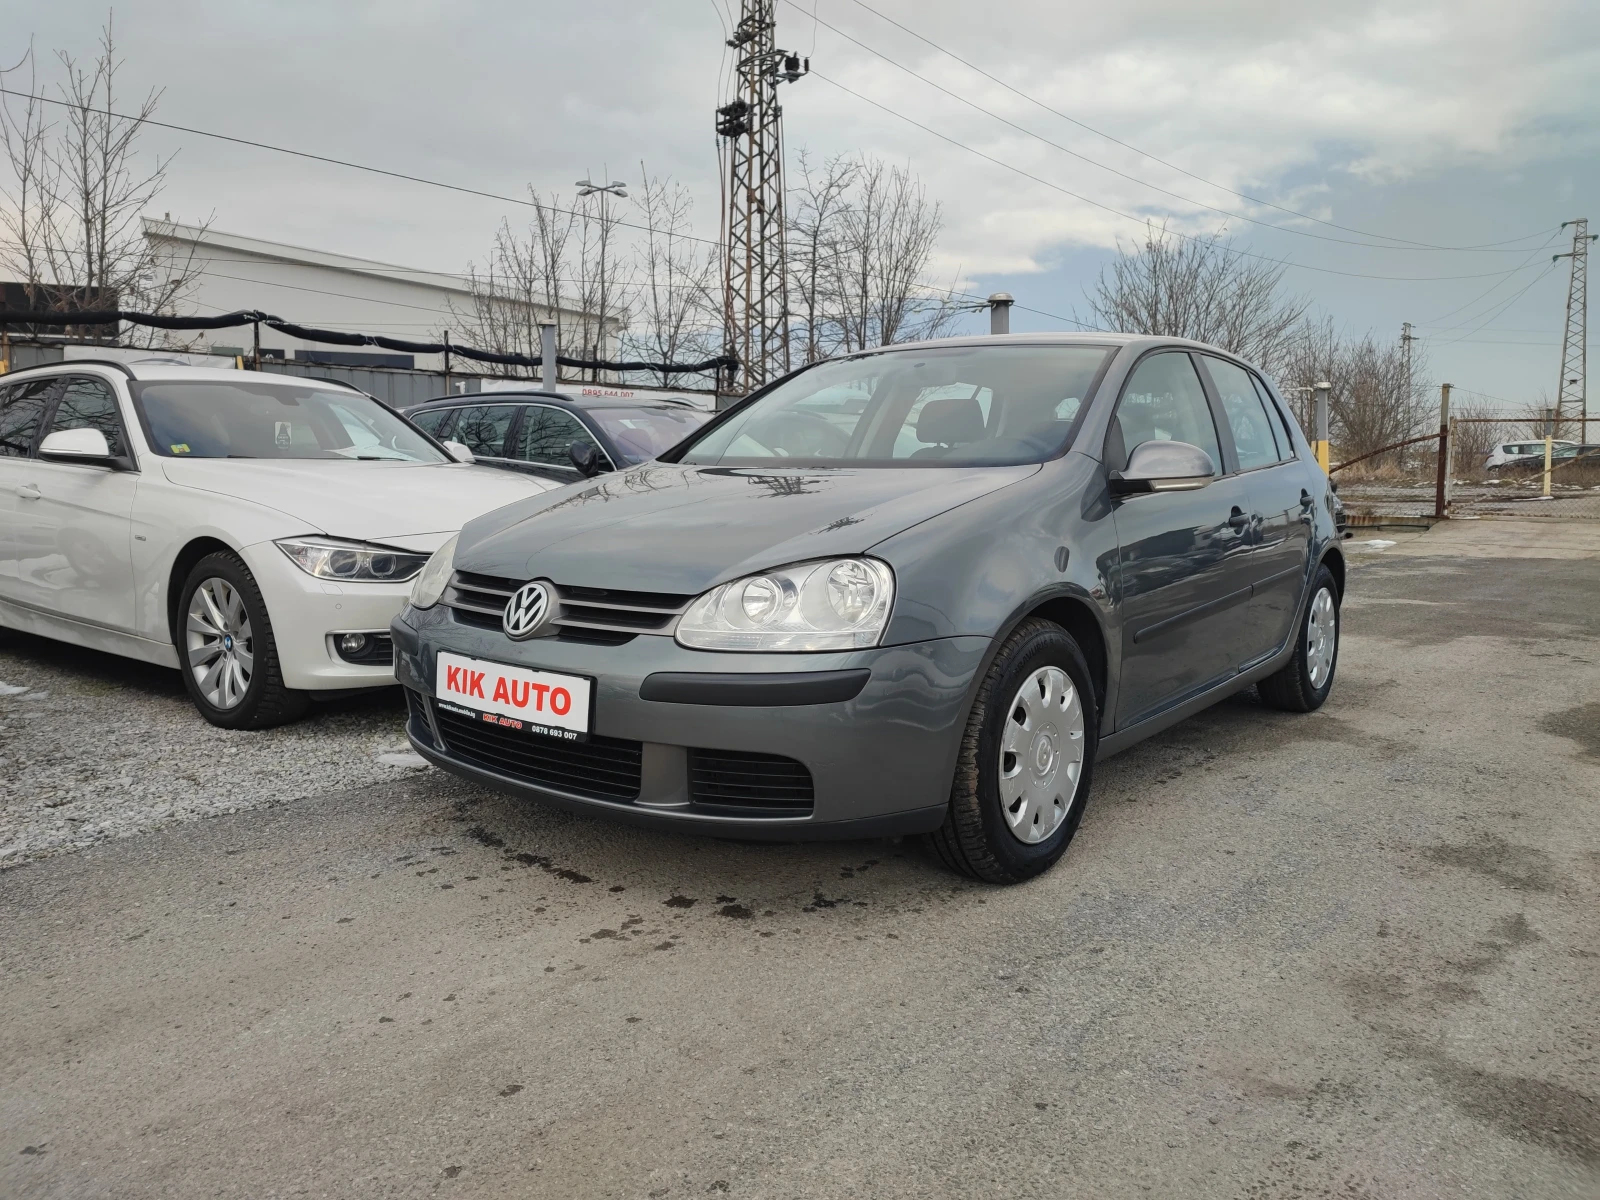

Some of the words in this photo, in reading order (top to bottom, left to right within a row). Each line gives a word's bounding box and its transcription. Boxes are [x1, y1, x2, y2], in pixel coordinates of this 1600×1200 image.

[446, 664, 485, 699] KIK
[492, 676, 572, 716] AUTO
[482, 713, 498, 724] KIK
[499, 717, 522, 730] AUTO
[531, 725, 548, 735] 0878
[549, 728, 562, 737] 693
[563, 731, 577, 740] 007
